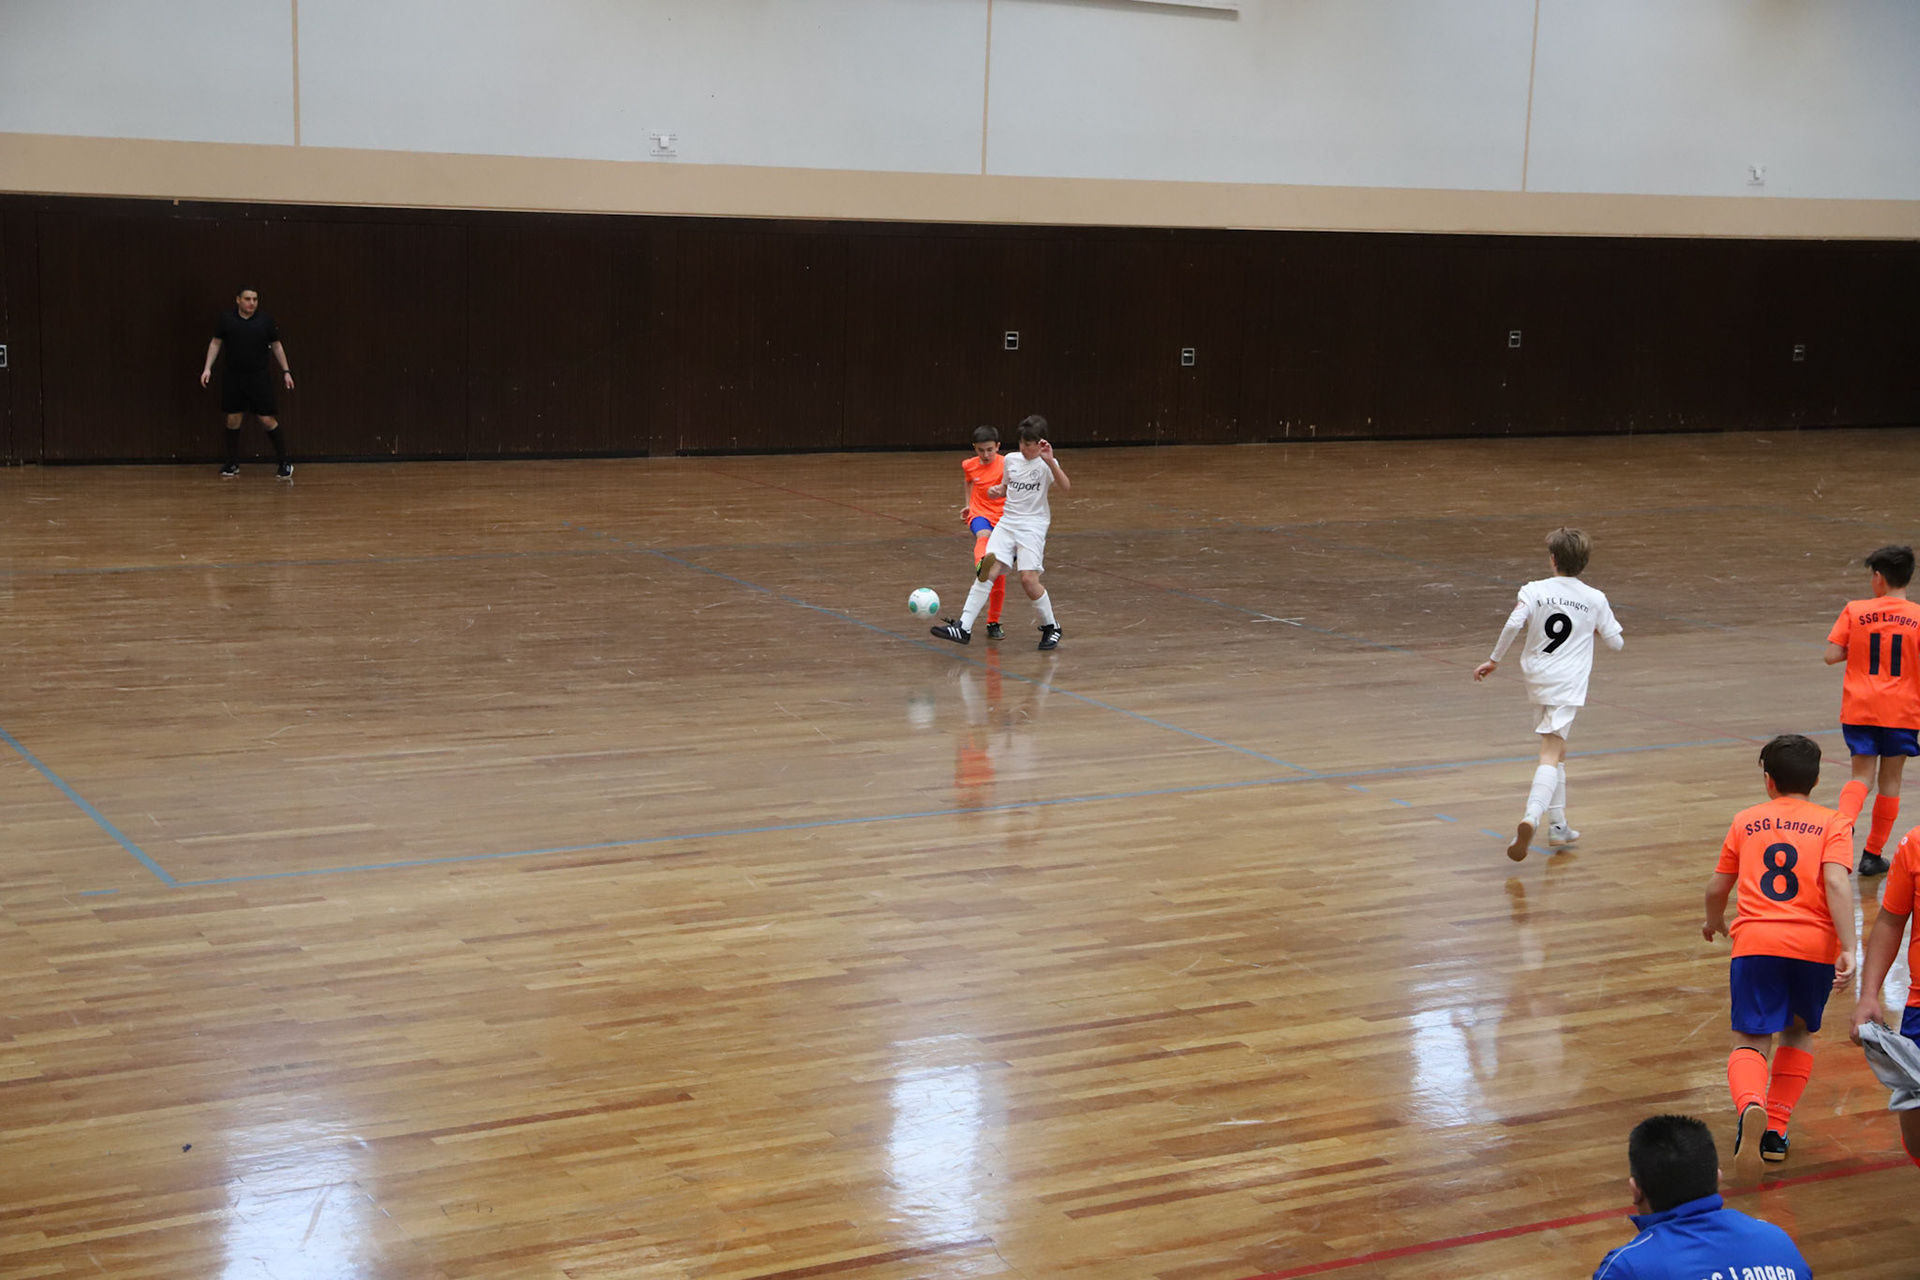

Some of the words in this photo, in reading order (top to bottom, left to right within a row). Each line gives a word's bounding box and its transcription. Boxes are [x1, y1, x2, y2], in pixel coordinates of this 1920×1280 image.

[1008, 478, 1041, 492] raport
[1559, 598, 1589, 613] Langen
[1859, 612, 1879, 626] SSG
[1882, 612, 1918, 629] Langen
[1542, 612, 1573, 654] 9
[1869, 632, 1903, 677] 11
[1745, 818, 1771, 836] SSG
[1776, 818, 1824, 836] Langen
[1760, 842, 1799, 902] 8
